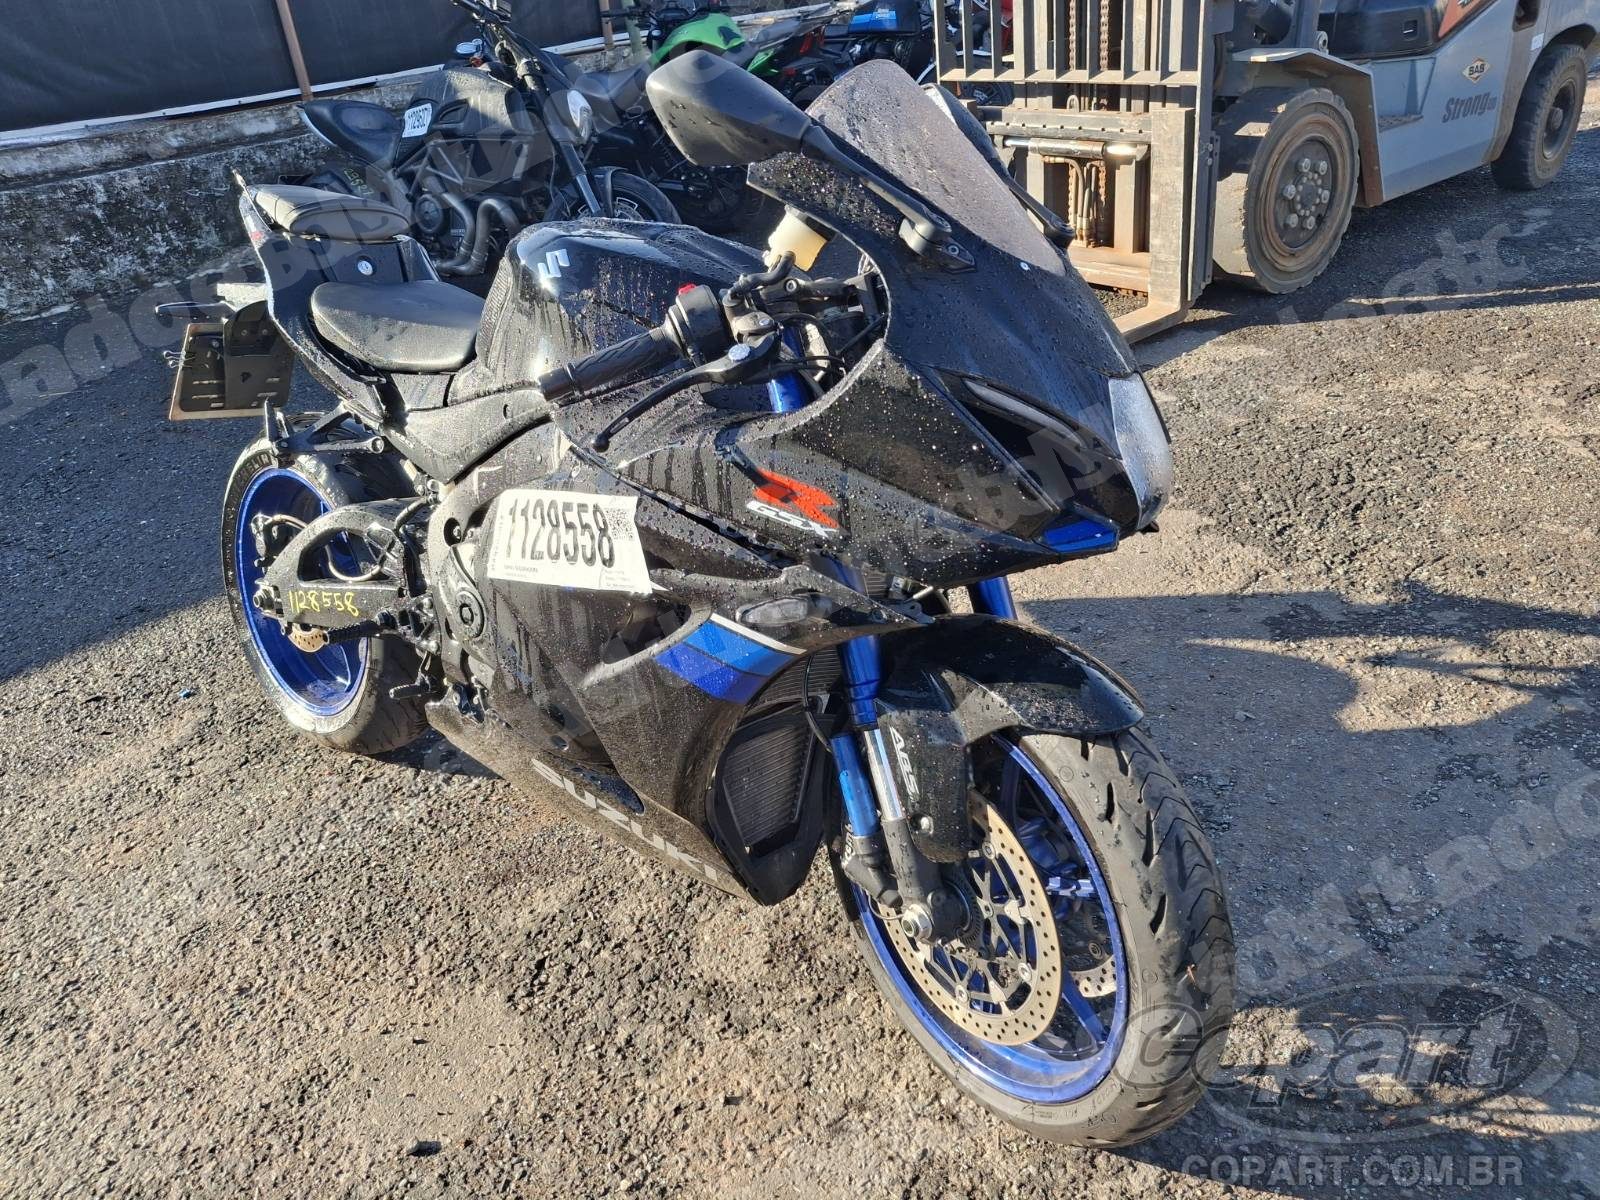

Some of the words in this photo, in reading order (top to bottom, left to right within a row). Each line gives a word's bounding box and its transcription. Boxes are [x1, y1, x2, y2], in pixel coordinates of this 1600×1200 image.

[1441, 92, 1491, 124] Strong
[505, 498, 616, 568] 1128558
[746, 500, 839, 539] GSX
[288, 590, 360, 617] 1128558
[889, 725, 921, 801] ABS
[531, 758, 718, 882] SUZUKI
